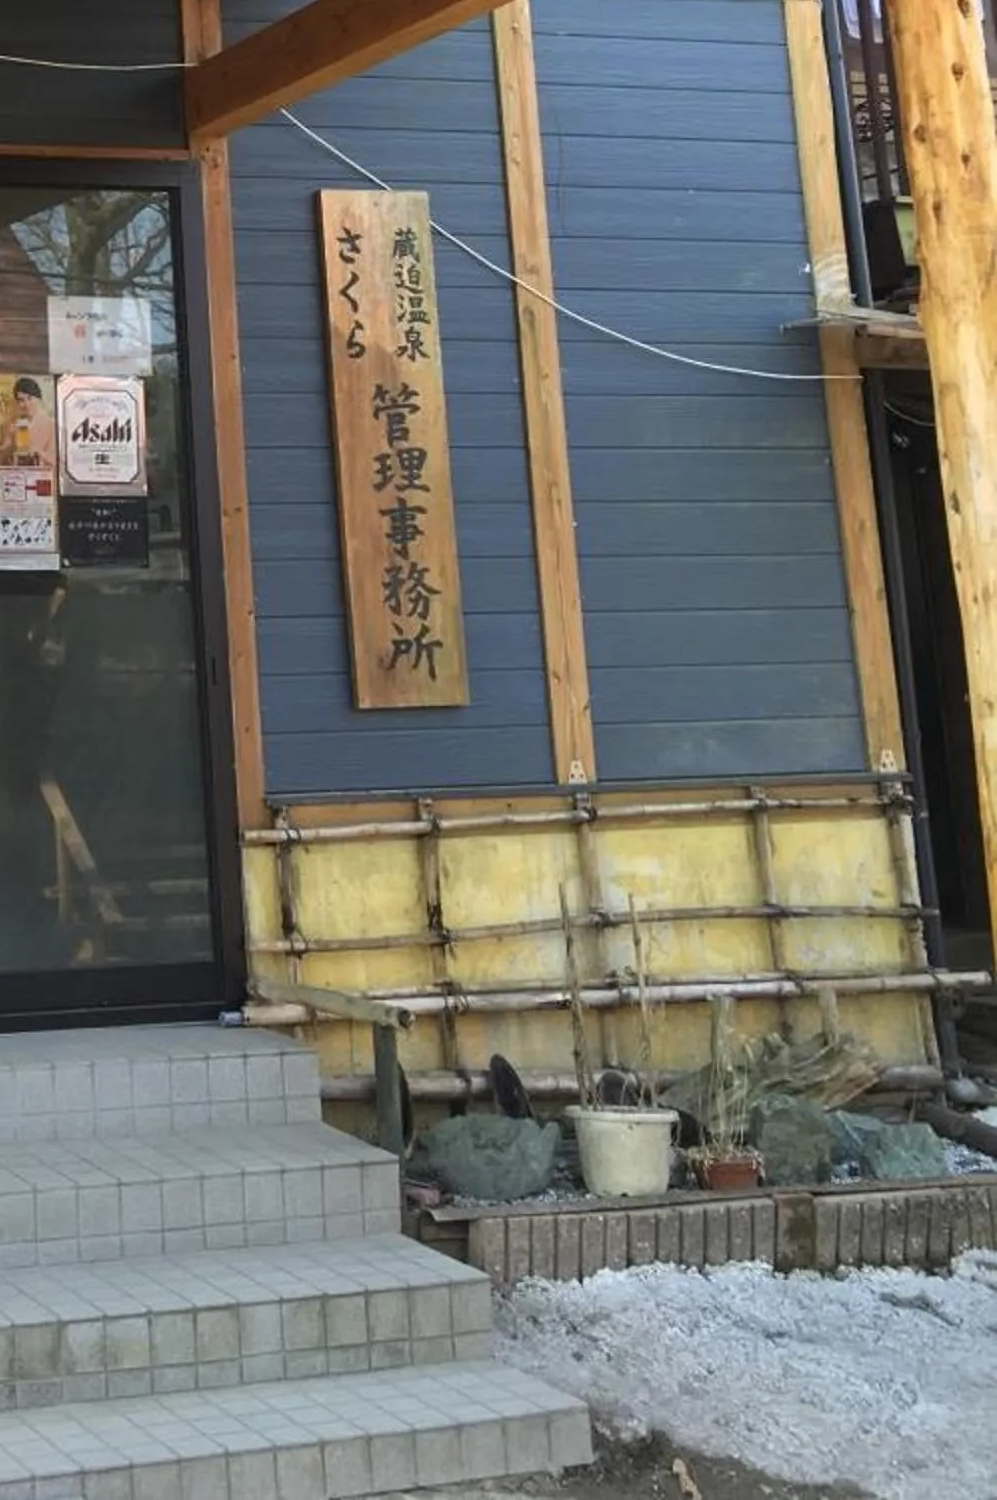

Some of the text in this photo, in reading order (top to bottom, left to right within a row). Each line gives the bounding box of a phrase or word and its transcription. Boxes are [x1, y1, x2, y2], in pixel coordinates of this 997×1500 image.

[335, 227, 366, 360] さくら
[71, 416, 133, 443] Asahi
[372, 382, 444, 682] 管理事務所
